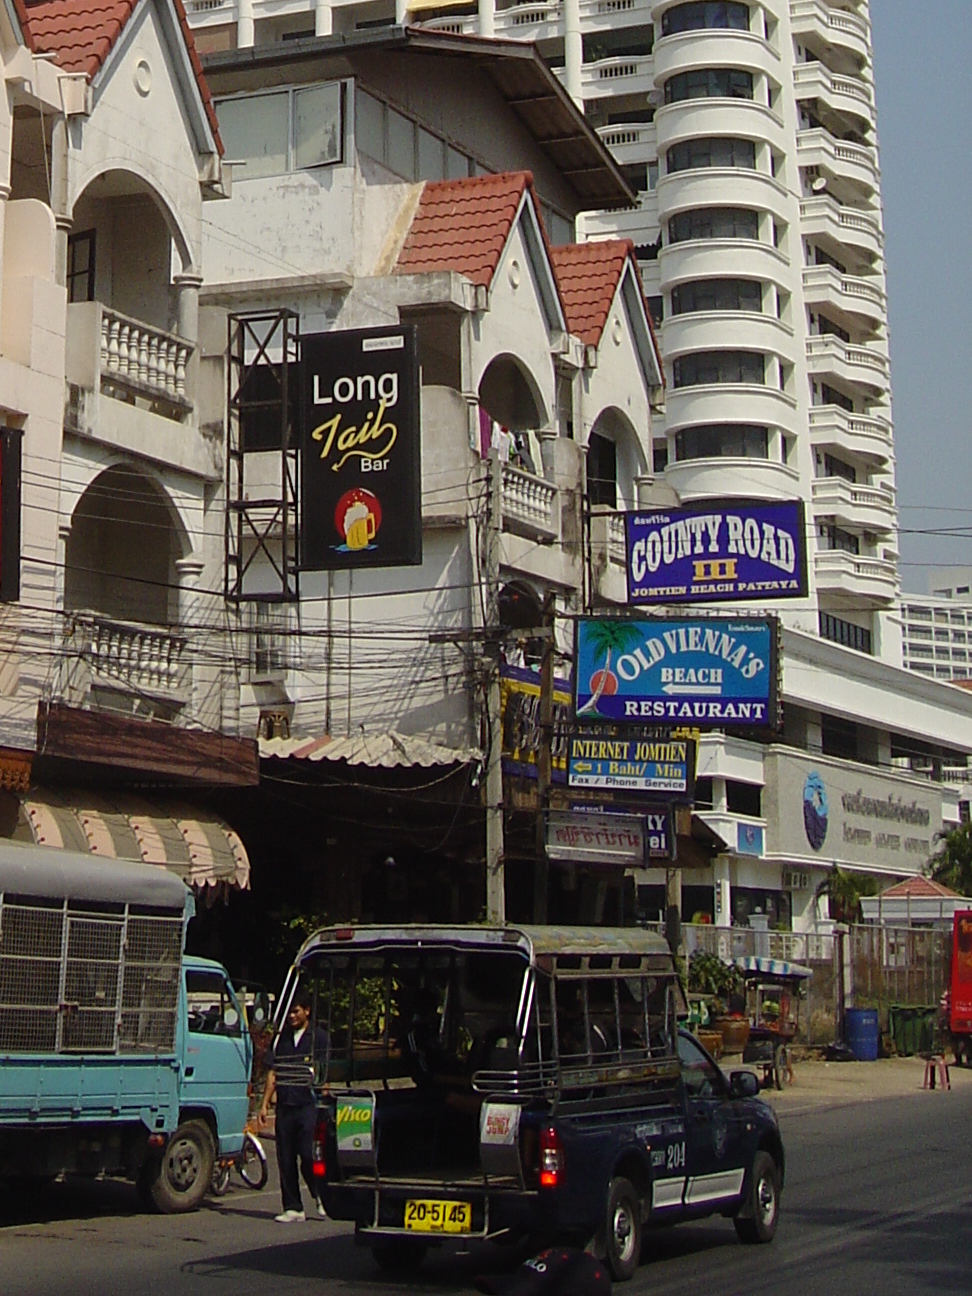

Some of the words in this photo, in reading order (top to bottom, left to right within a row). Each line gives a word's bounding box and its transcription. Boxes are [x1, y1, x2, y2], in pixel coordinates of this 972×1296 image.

[312, 372, 399, 408] Long
[312, 398, 396, 461] Tail
[360, 457, 390, 473] Bar
[631, 514, 723, 583] COUNTY
[726, 515, 796, 574] ROAD
[692, 558, 738, 581] III
[631, 585, 687, 597] JOMTIEN
[690, 583, 734, 594] BEACH
[737, 579, 799, 591] PATTAYA
[616, 637, 666, 681] OLD
[662, 627, 765, 679] VIENNA'S
[660, 667, 724, 684] BEACH
[624, 700, 765, 719] RESTAURANT
[572, 739, 630, 760] INTERNET
[635, 742, 687, 762] JOMTIEN
[655, 764, 683, 778] Min
[571, 775, 590, 785] Fax
[605, 776, 638, 787] Phone
[644, 778, 685, 790] Service
[408, 1203, 467, 1223] 20-5145
